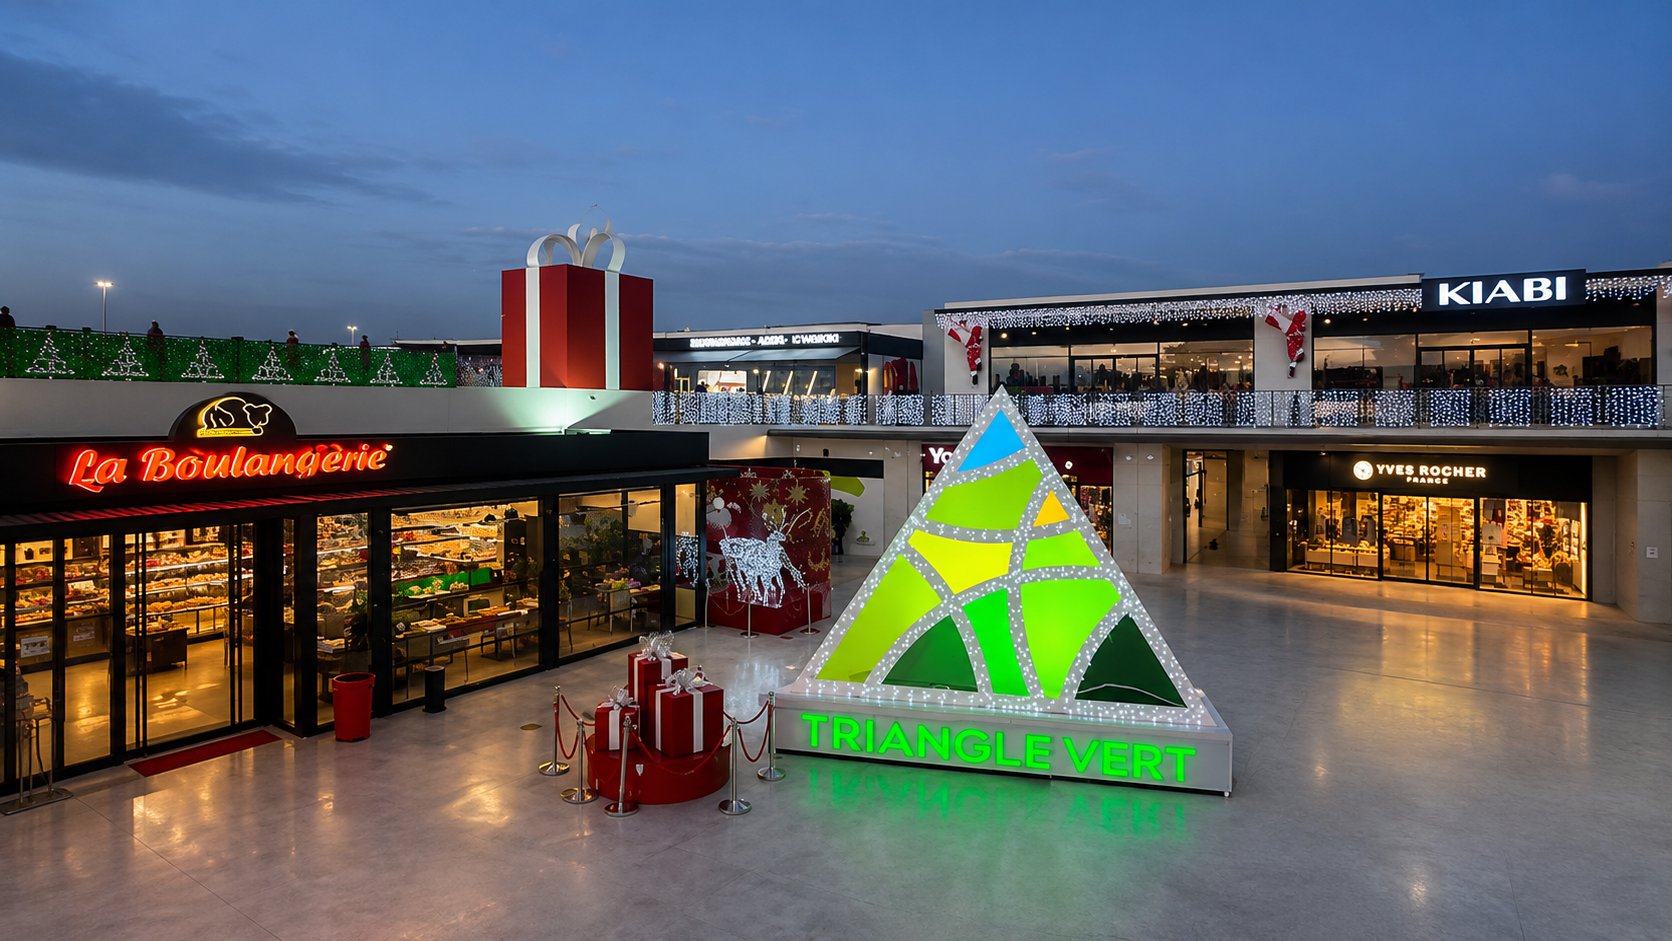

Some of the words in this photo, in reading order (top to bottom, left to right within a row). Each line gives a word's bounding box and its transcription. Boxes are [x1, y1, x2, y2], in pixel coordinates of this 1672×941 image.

[1438, 276, 1566, 306] KIABI
[68, 449, 128, 493] La
[1376, 464, 1415, 476] YVES
[1419, 465, 1487, 478] ROCHER
[801, 713, 1052, 770] TRIANGLE
[1063, 736, 1197, 783] VERT
